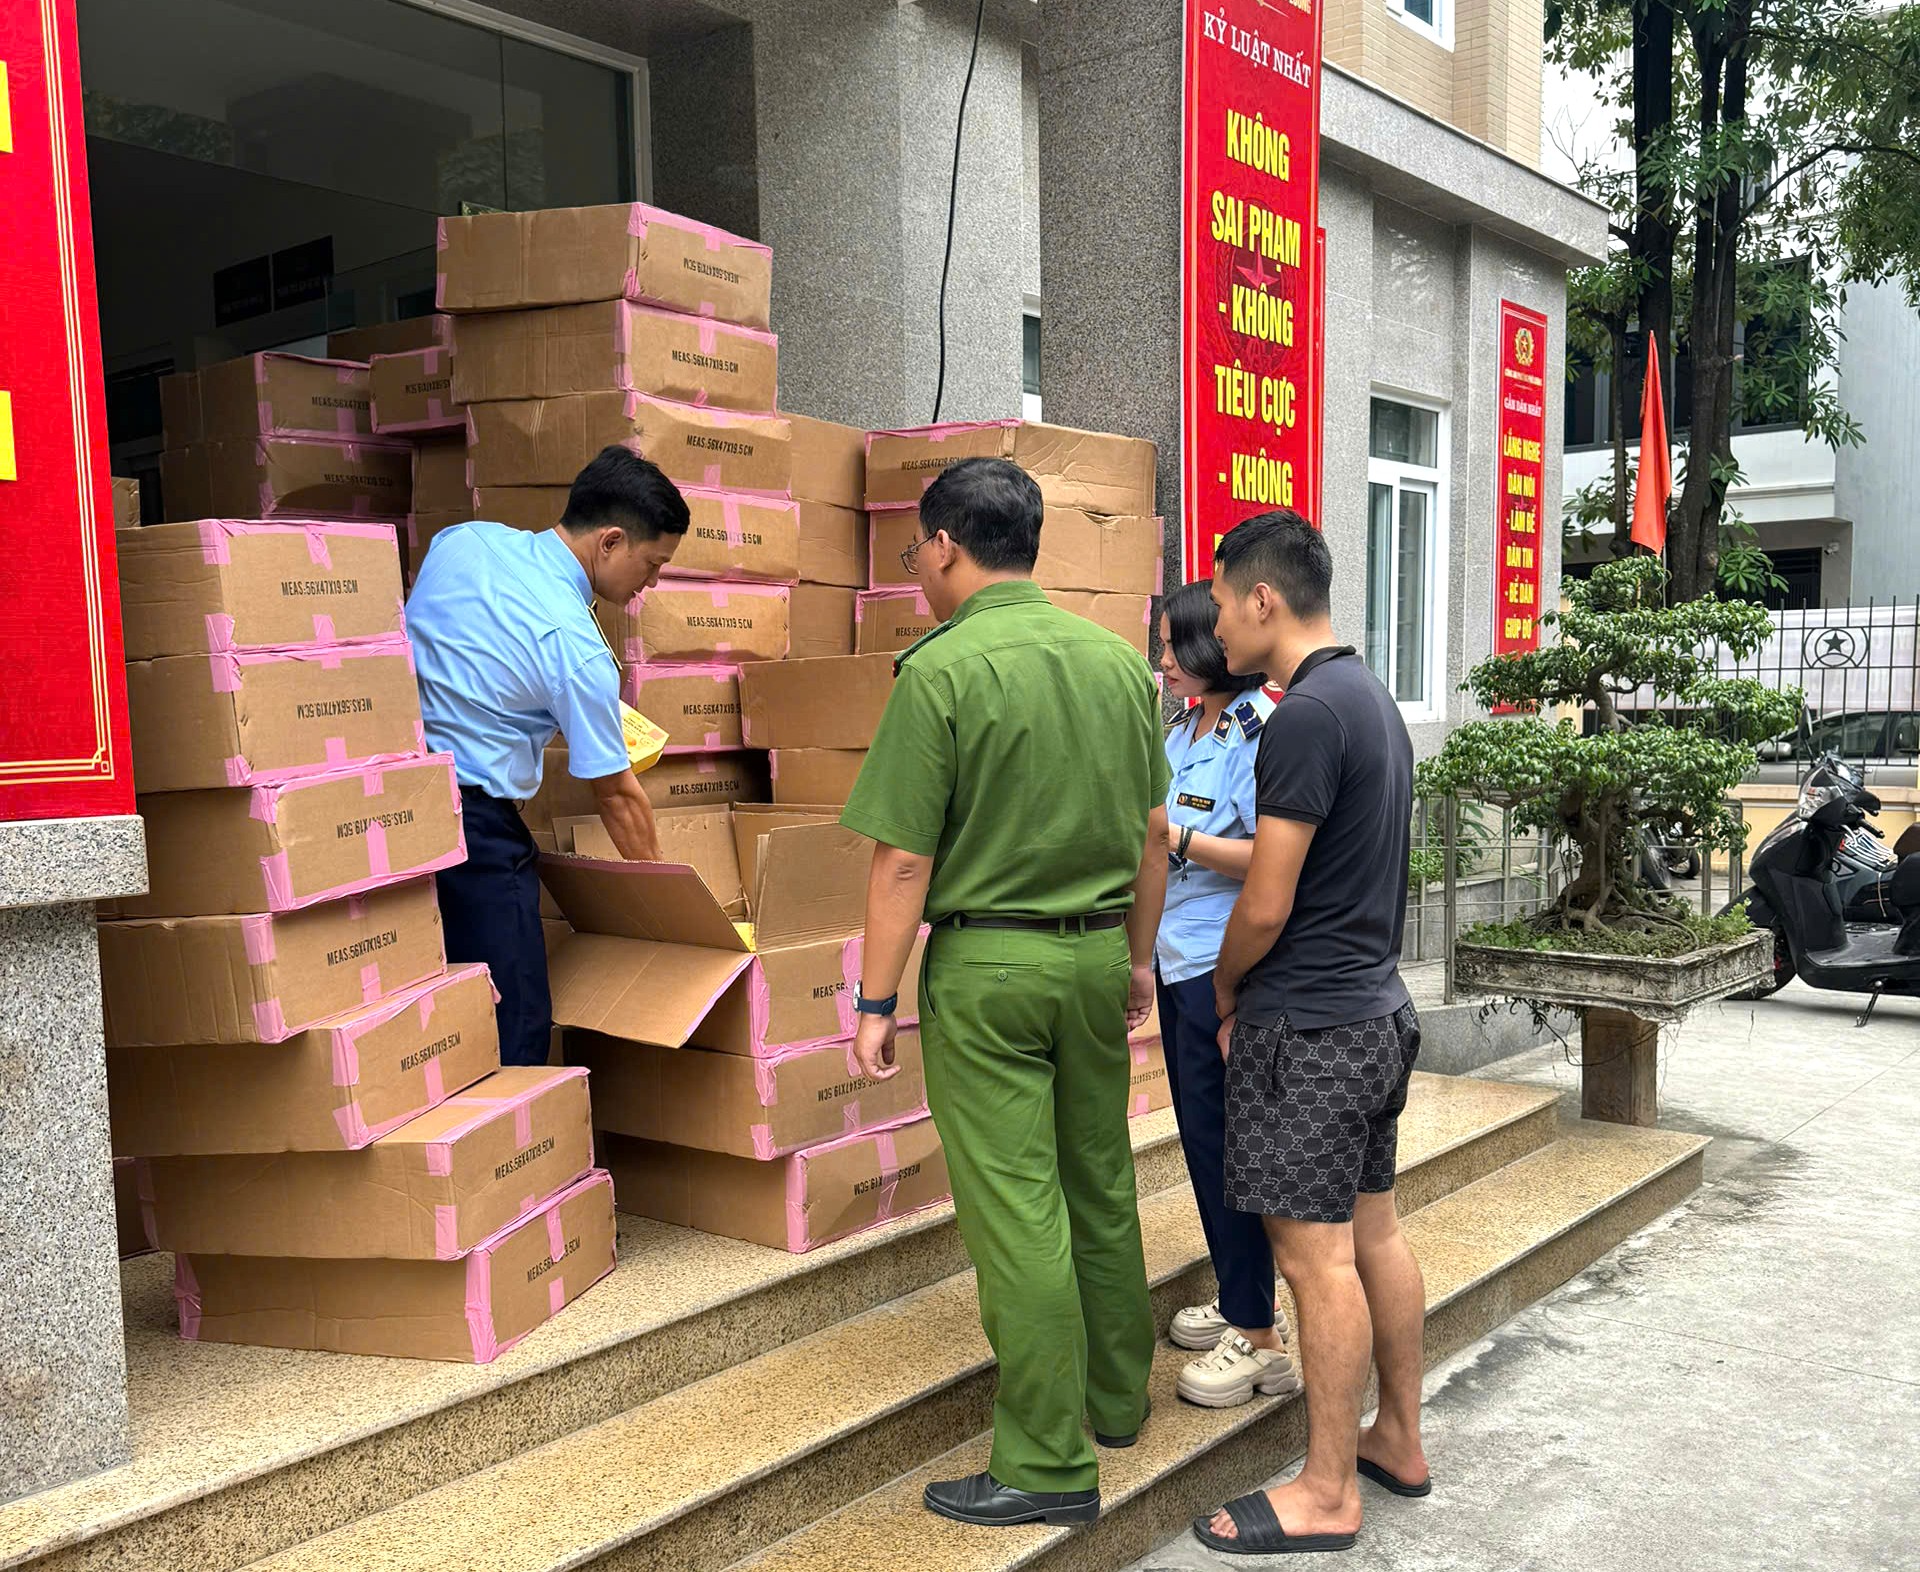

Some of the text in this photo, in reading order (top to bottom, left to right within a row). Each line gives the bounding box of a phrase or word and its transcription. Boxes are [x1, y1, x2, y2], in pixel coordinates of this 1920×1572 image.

[1203, 7, 1312, 89] KỶ LUẬT NHẤT
[1227, 108, 1290, 182] KHÔNG
[1211, 190, 1301, 273] SAI PHẠM
[1232, 282, 1293, 347] KHÔNG
[671, 350, 739, 373] MEAS:56X47X19.5CM
[1214, 358, 1296, 436] TIÊU CỰC
[687, 434, 754, 457] MEAS:56X47X19.5CM
[1232, 447, 1293, 508] KHÔNG
[696, 527, 762, 545] MEAS:56X9.5CM
[281, 579, 359, 596] MEAS:56X47X19.5CM
[297, 698, 373, 720] MEAS:56X47X19.5CM
[327, 929, 397, 967] MEAS:56X47X19.5CM
[400, 1030, 461, 1072] MEAS:56X47X19.5CM
[495, 1136, 555, 1181] MEAS:56X47X19.5CM
[527, 1235, 581, 1283] MEAS:56.5CM
